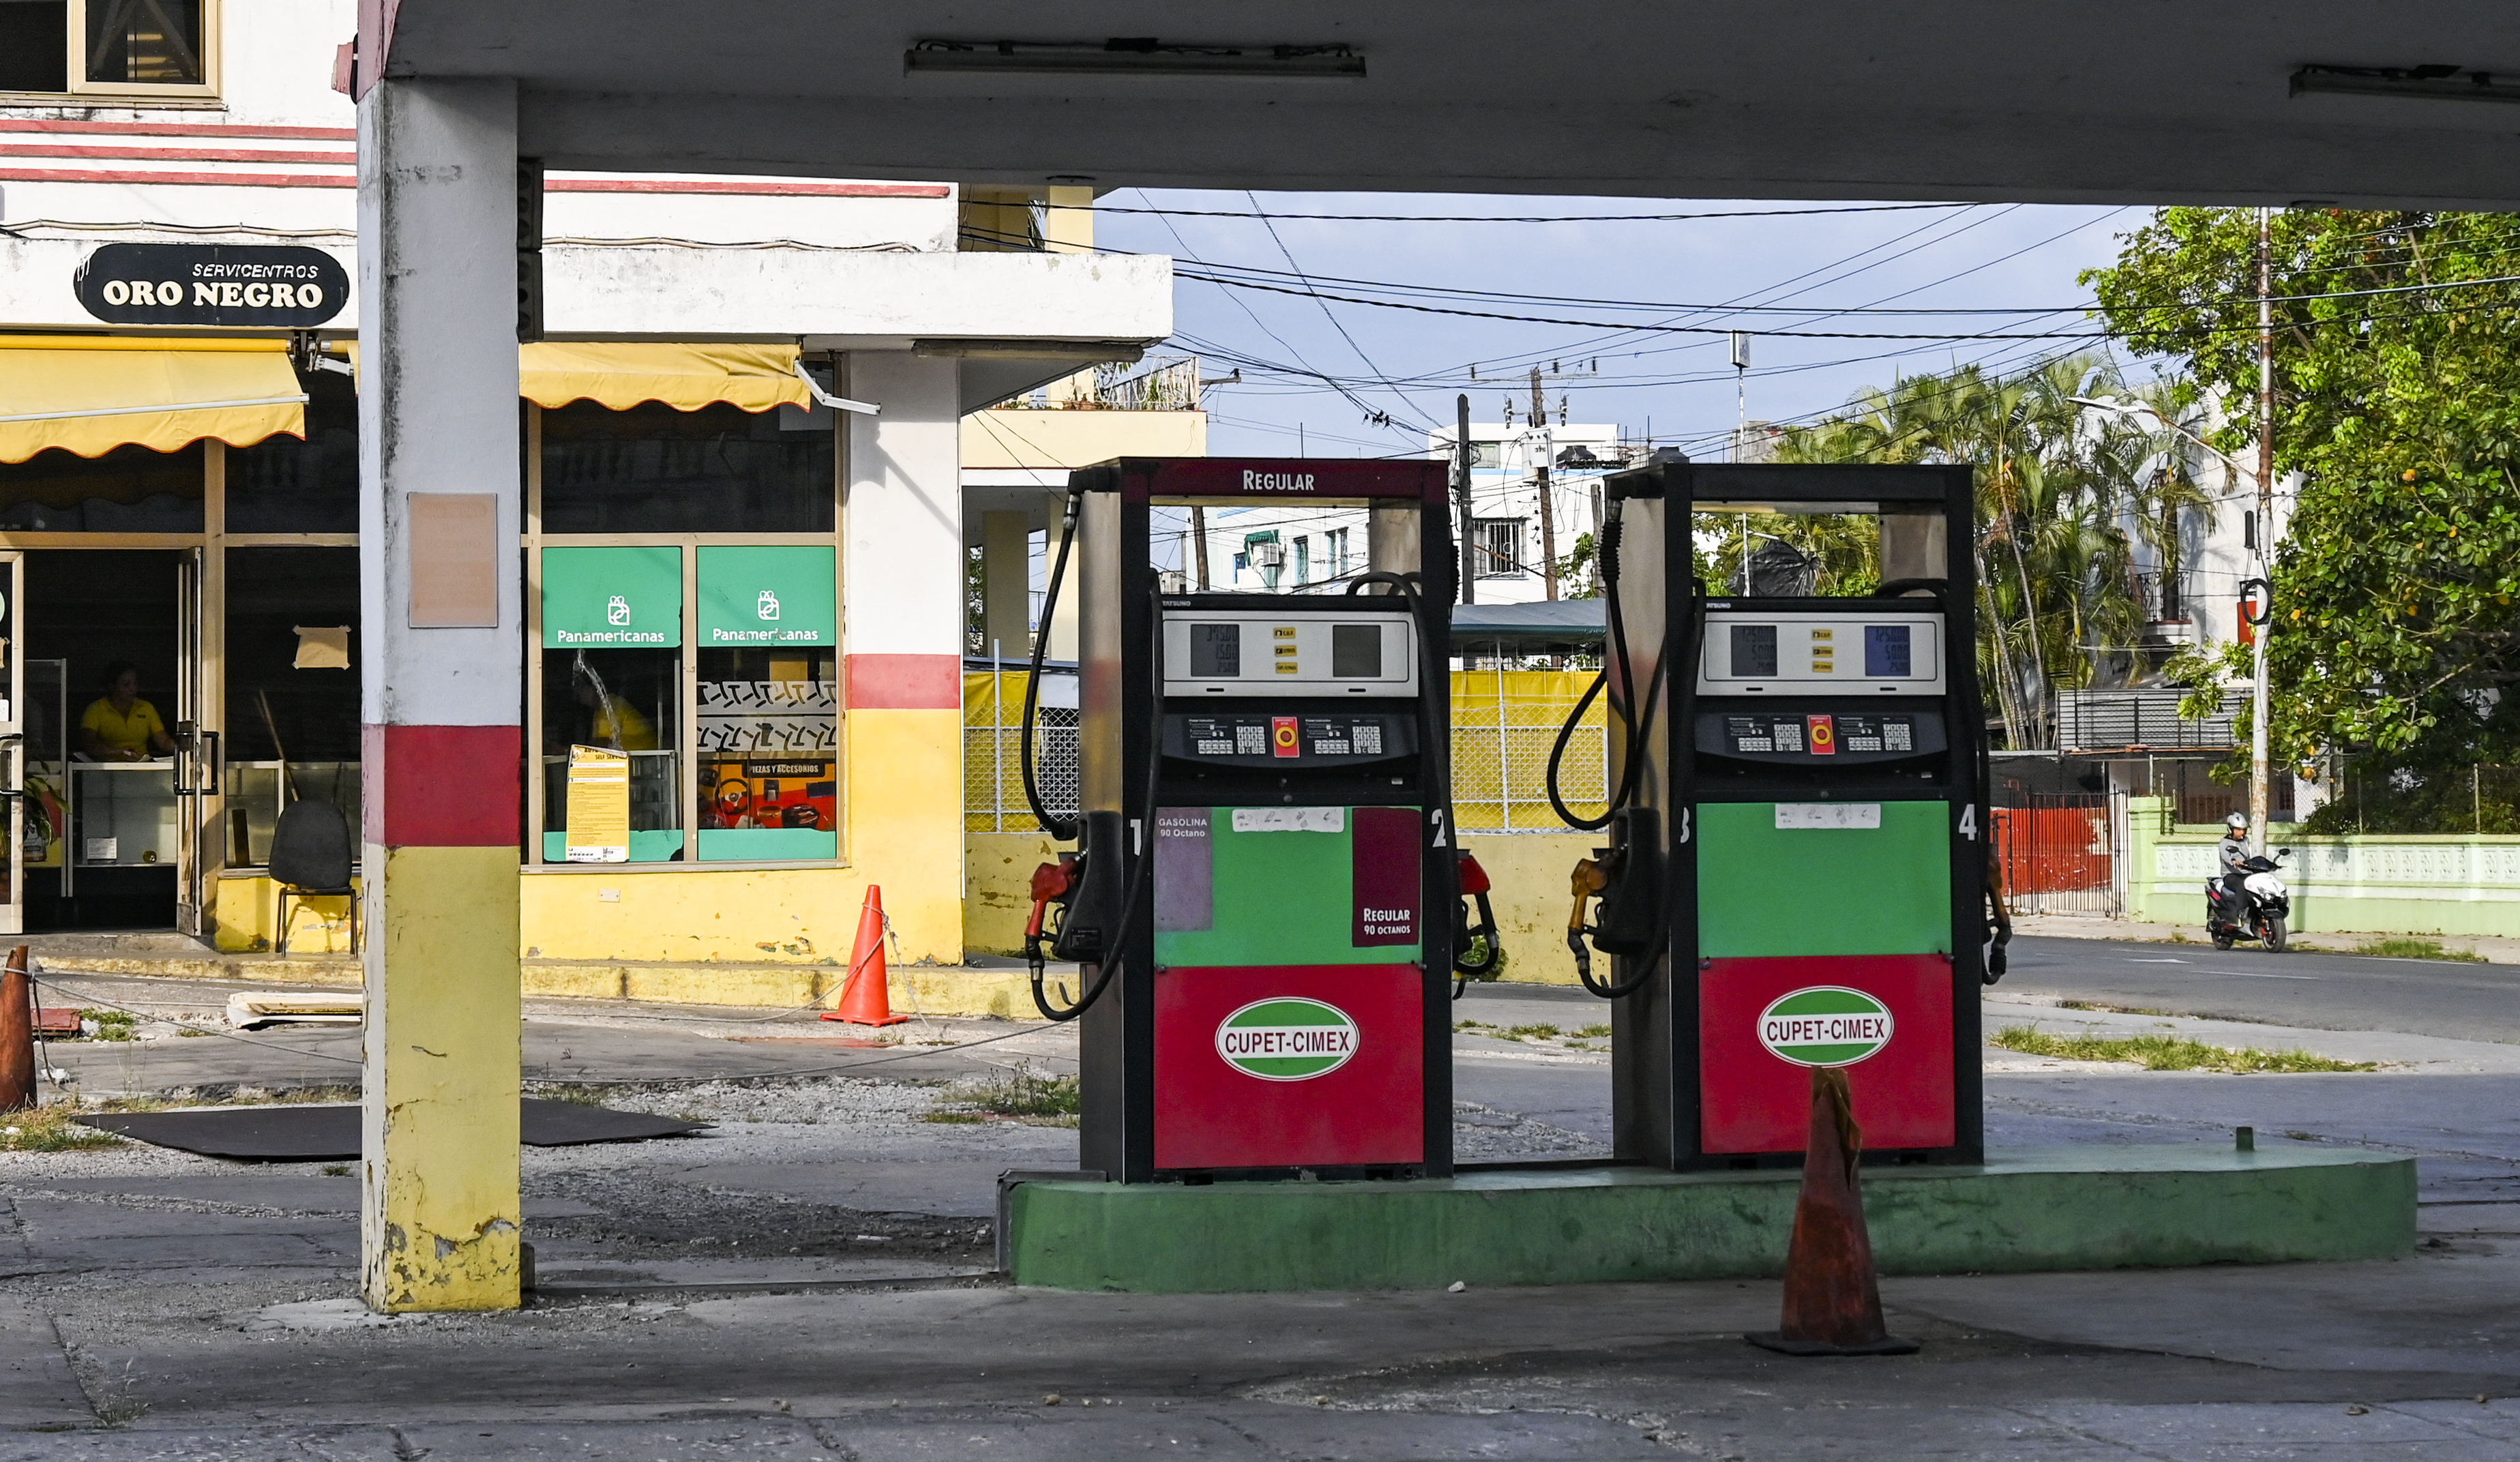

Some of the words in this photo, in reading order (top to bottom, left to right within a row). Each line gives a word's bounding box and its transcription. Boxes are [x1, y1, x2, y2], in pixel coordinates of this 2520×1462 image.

[192, 263, 319, 279] SERVICENTROS
[102, 280, 183, 307] ORO
[192, 282, 324, 308] NEGRO
[557, 629, 665, 644] Panamericanas
[713, 628, 819, 641] Panamericanas
[771, 765, 777, 774] Y
[777, 764, 819, 773] ACCESORIOS
[1159, 818, 1208, 827] GASOLINA
[1431, 808, 1447, 848] 2
[1959, 803, 1978, 841] 4
[1130, 818, 1142, 857] 1
[1160, 829, 1171, 837] 90
[1173, 829, 1206, 837] Octano
[1364, 924, 1376, 936] 90
[1377, 925, 1411, 935] OCTANOS
[1767, 1018, 1885, 1042] CUPET-CIMEX
[1225, 1031, 1350, 1054] CUPET-CIMEX
